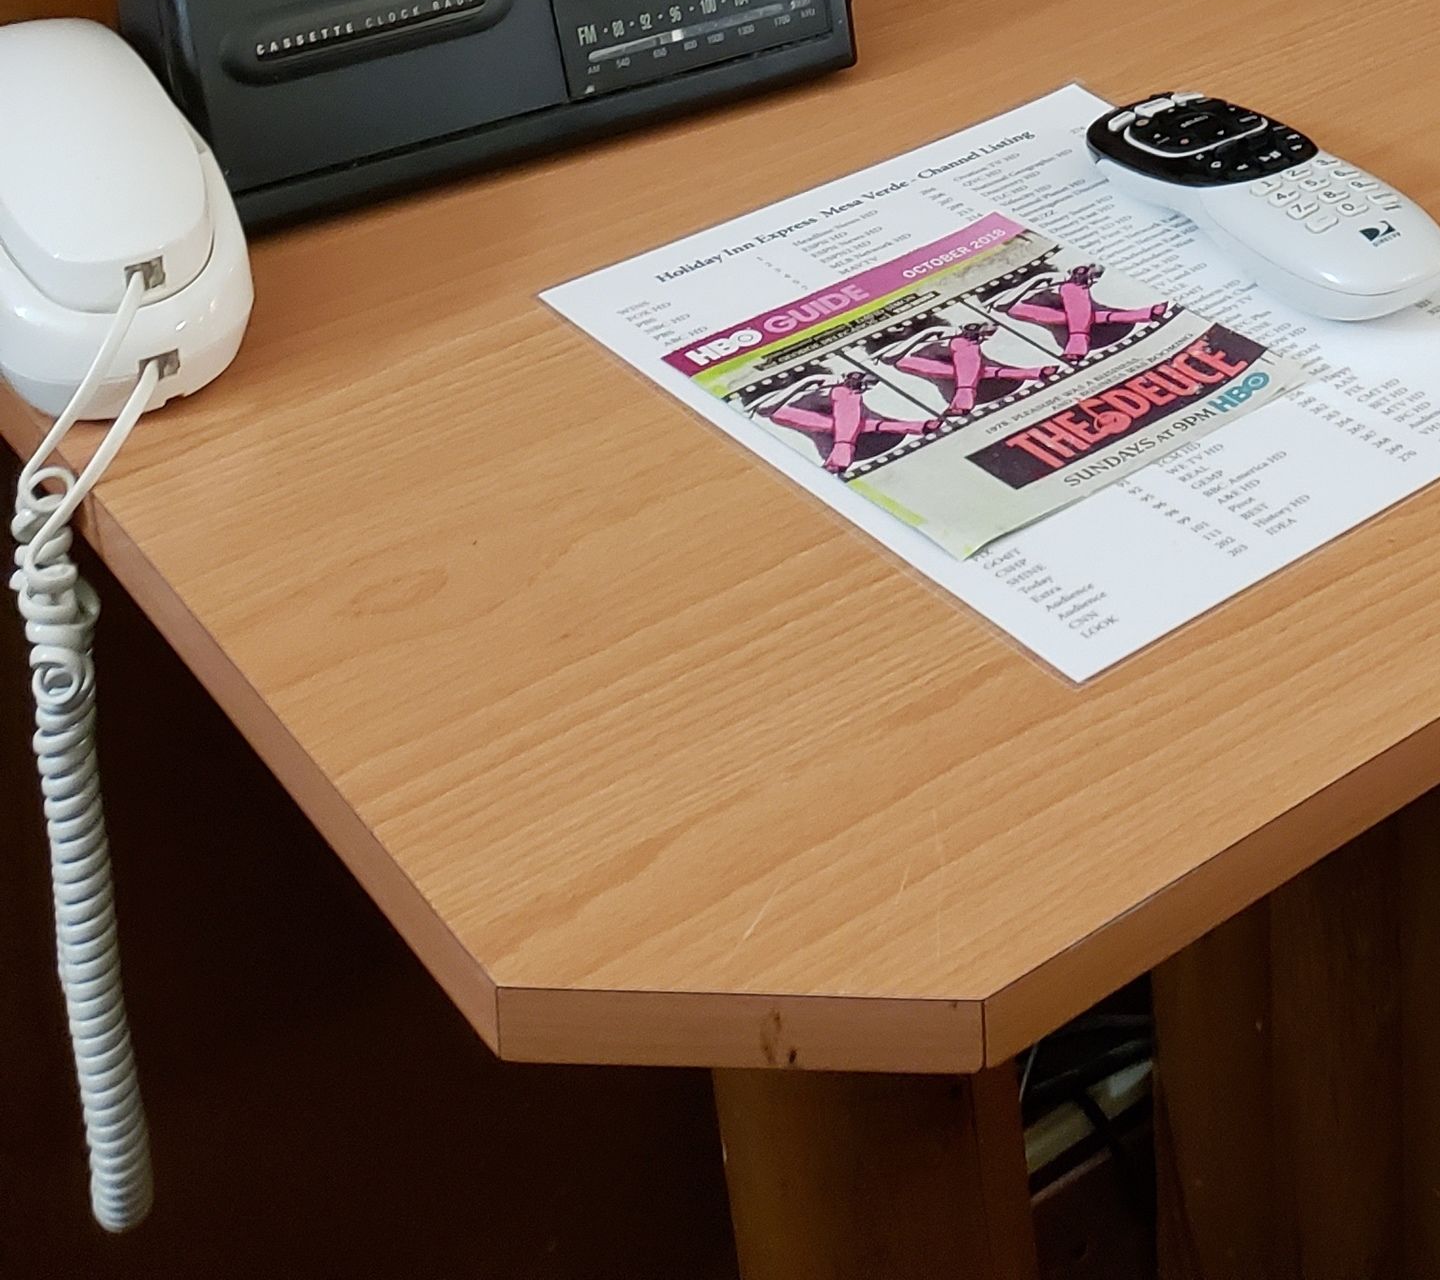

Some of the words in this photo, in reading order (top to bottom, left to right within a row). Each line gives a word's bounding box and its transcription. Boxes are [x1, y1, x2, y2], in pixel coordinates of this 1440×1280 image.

[256, 22, 354, 55] CASSETTE
[365, 6, 421, 28] CLOCK
[577, 25, 597, 46] FM
[656, 254, 723, 283] Holiday
[723, 241, 755, 256] Inn
[755, 217, 818, 244] Express
[820, 199, 864, 218] Mesa
[861, 179, 909, 201] Verde
[917, 151, 981, 180] Channel
[979, 131, 1035, 155] Listing
[902, 246, 971, 279] OCTOBER
[684, 328, 763, 367] HBO
[763, 284, 870, 334] GUIDE
[1005, 408, 1100, 469] THE
[1107, 341, 1248, 419] DEUCE
[1063, 437, 1157, 487] SUNDAYS
[1156, 428, 1176, 444] AT
[1172, 408, 1218, 433] 9PM
[1207, 371, 1270, 413] HBO
